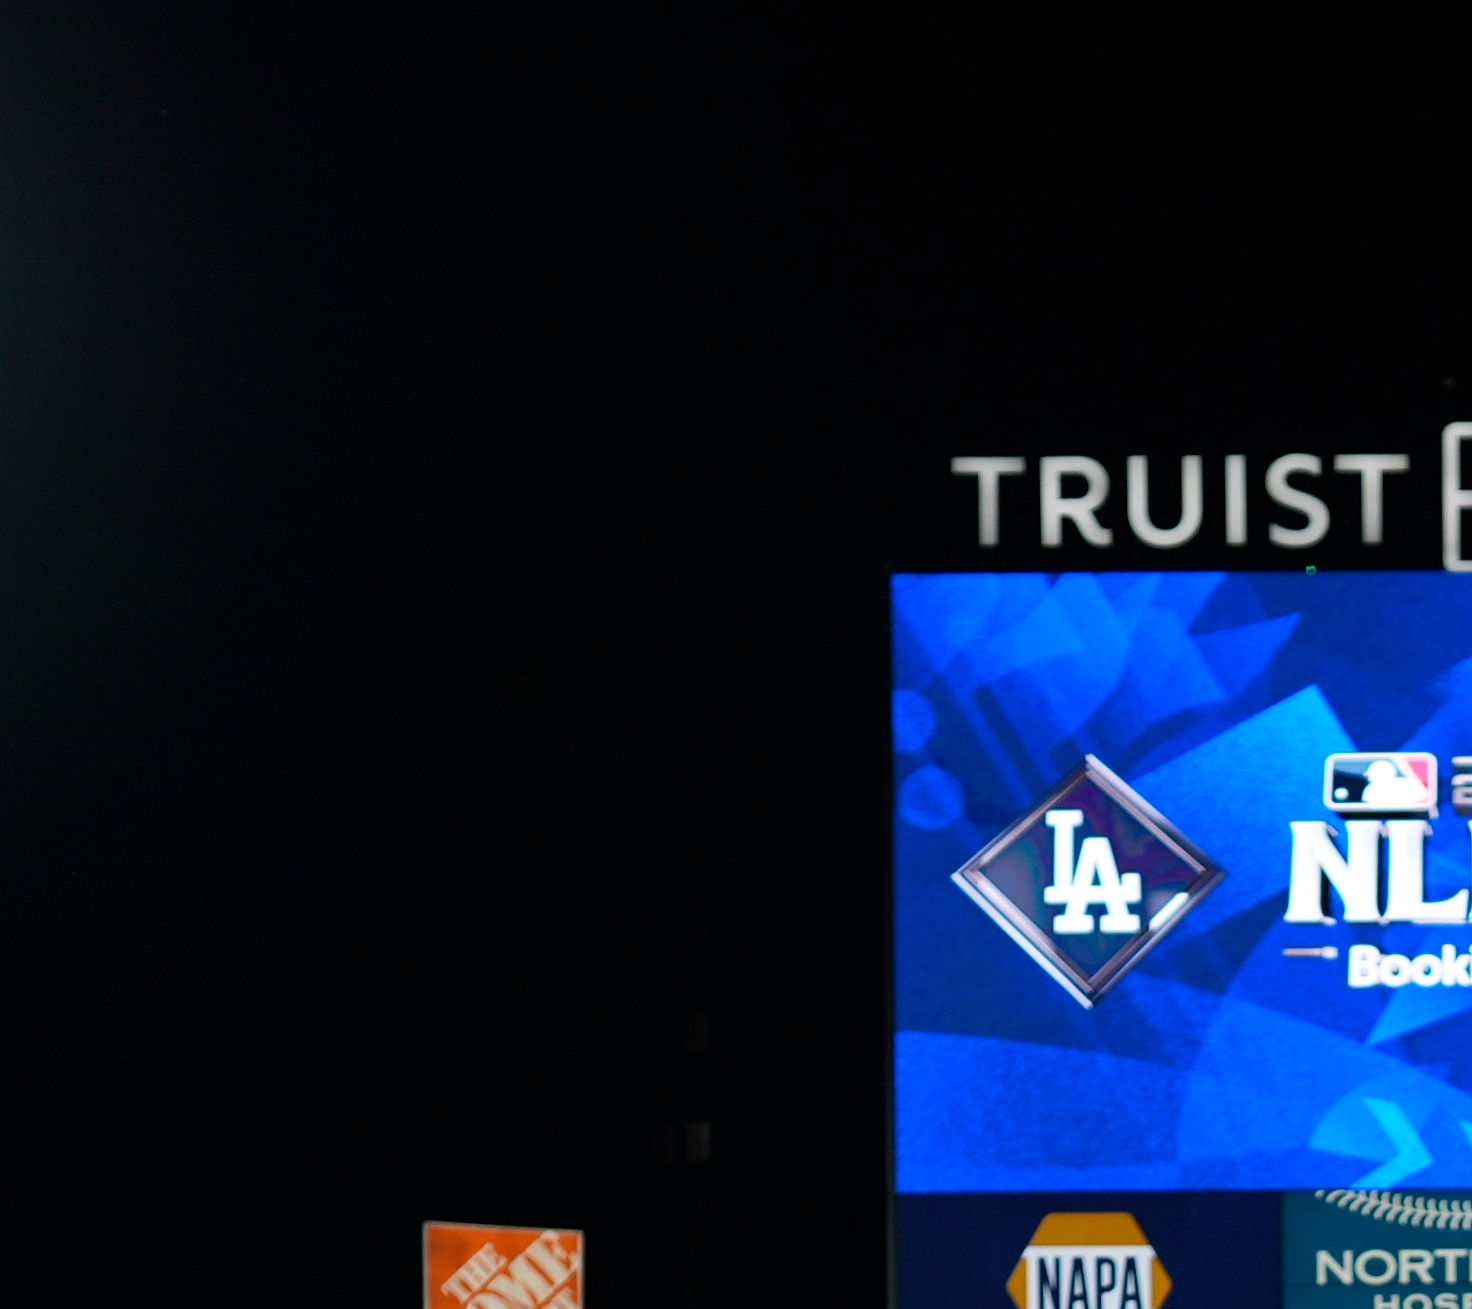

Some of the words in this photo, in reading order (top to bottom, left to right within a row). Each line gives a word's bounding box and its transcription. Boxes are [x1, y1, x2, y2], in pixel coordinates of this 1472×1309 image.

[950, 453, 1410, 548] TRUIST
[1043, 808, 1141, 936] LA
[440, 1241, 510, 1305] THE
